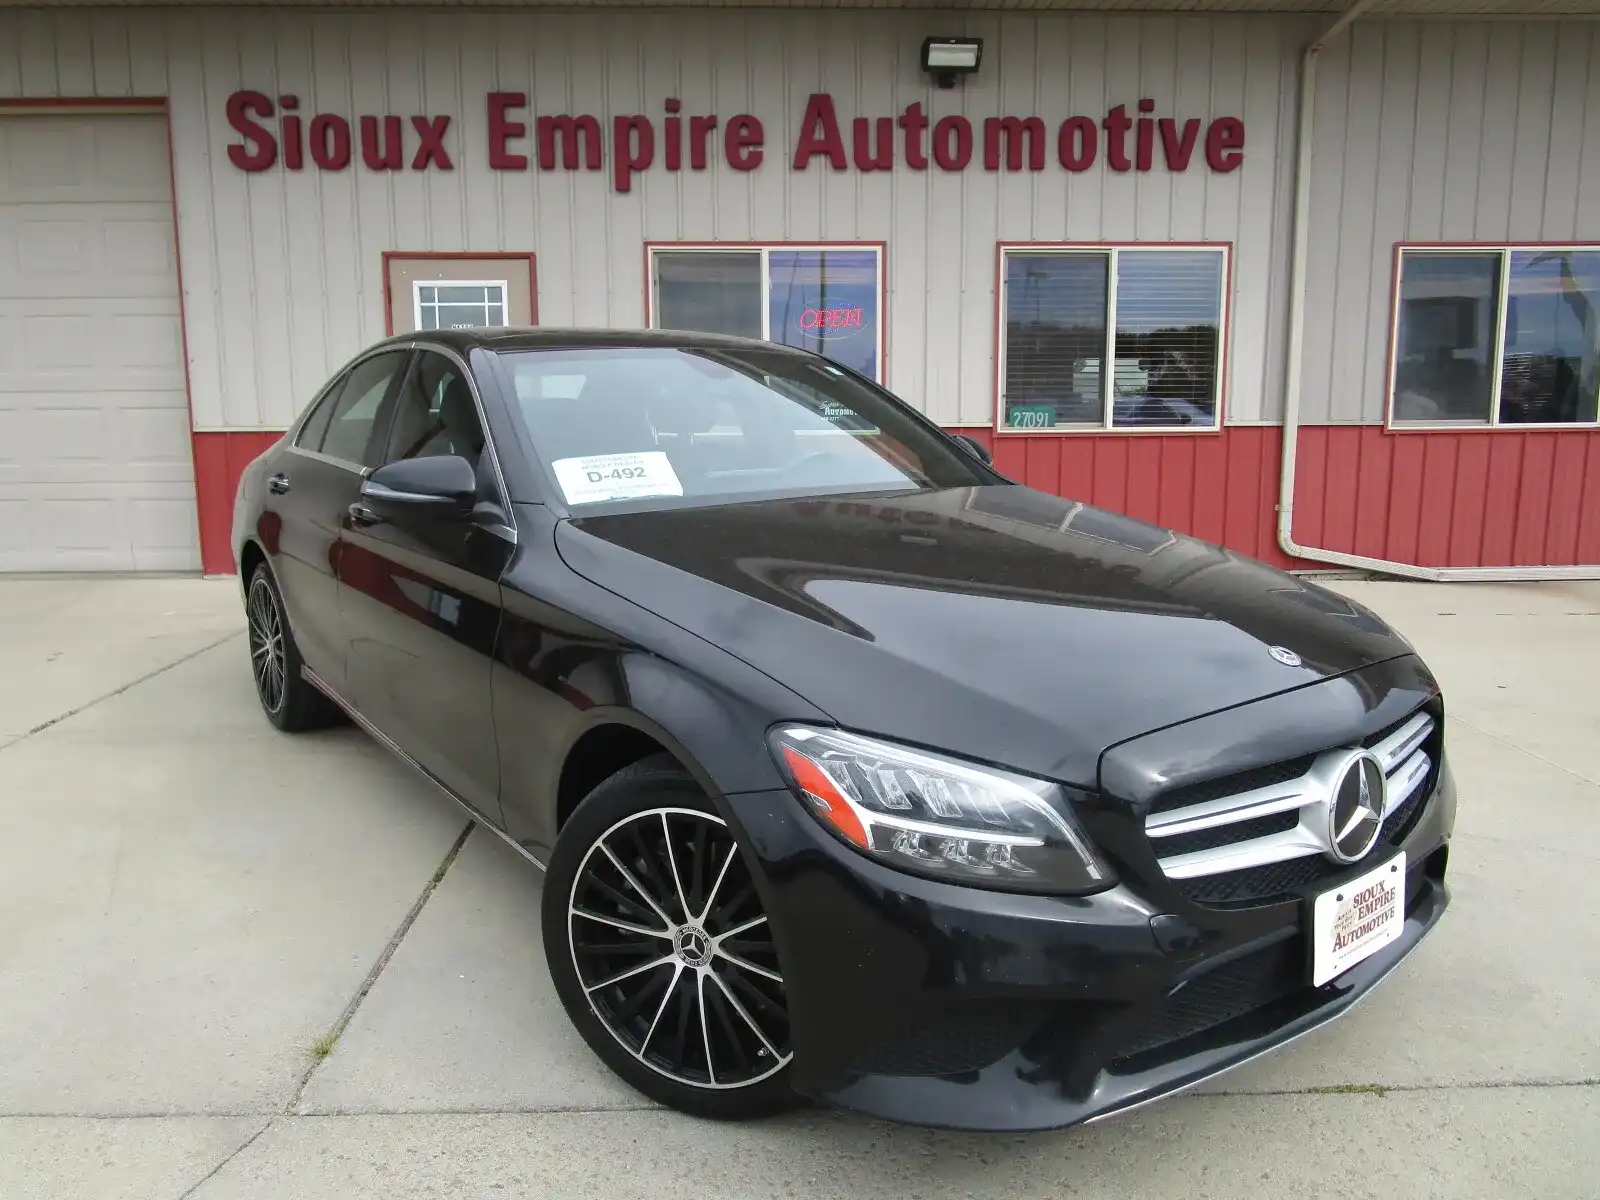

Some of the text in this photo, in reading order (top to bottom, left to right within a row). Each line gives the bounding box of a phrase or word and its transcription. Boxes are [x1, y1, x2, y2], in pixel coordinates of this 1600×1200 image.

[225, 90, 1246, 193] Sioux Empire Automotive
[798, 307, 863, 328] OPEN
[1013, 411, 1049, 428] 27091
[586, 466, 648, 483] D-492
[1353, 880, 1385, 908] SIOUX
[1358, 887, 1396, 921] EMPIRE
[1332, 906, 1395, 953] AUTOMOTIVE
